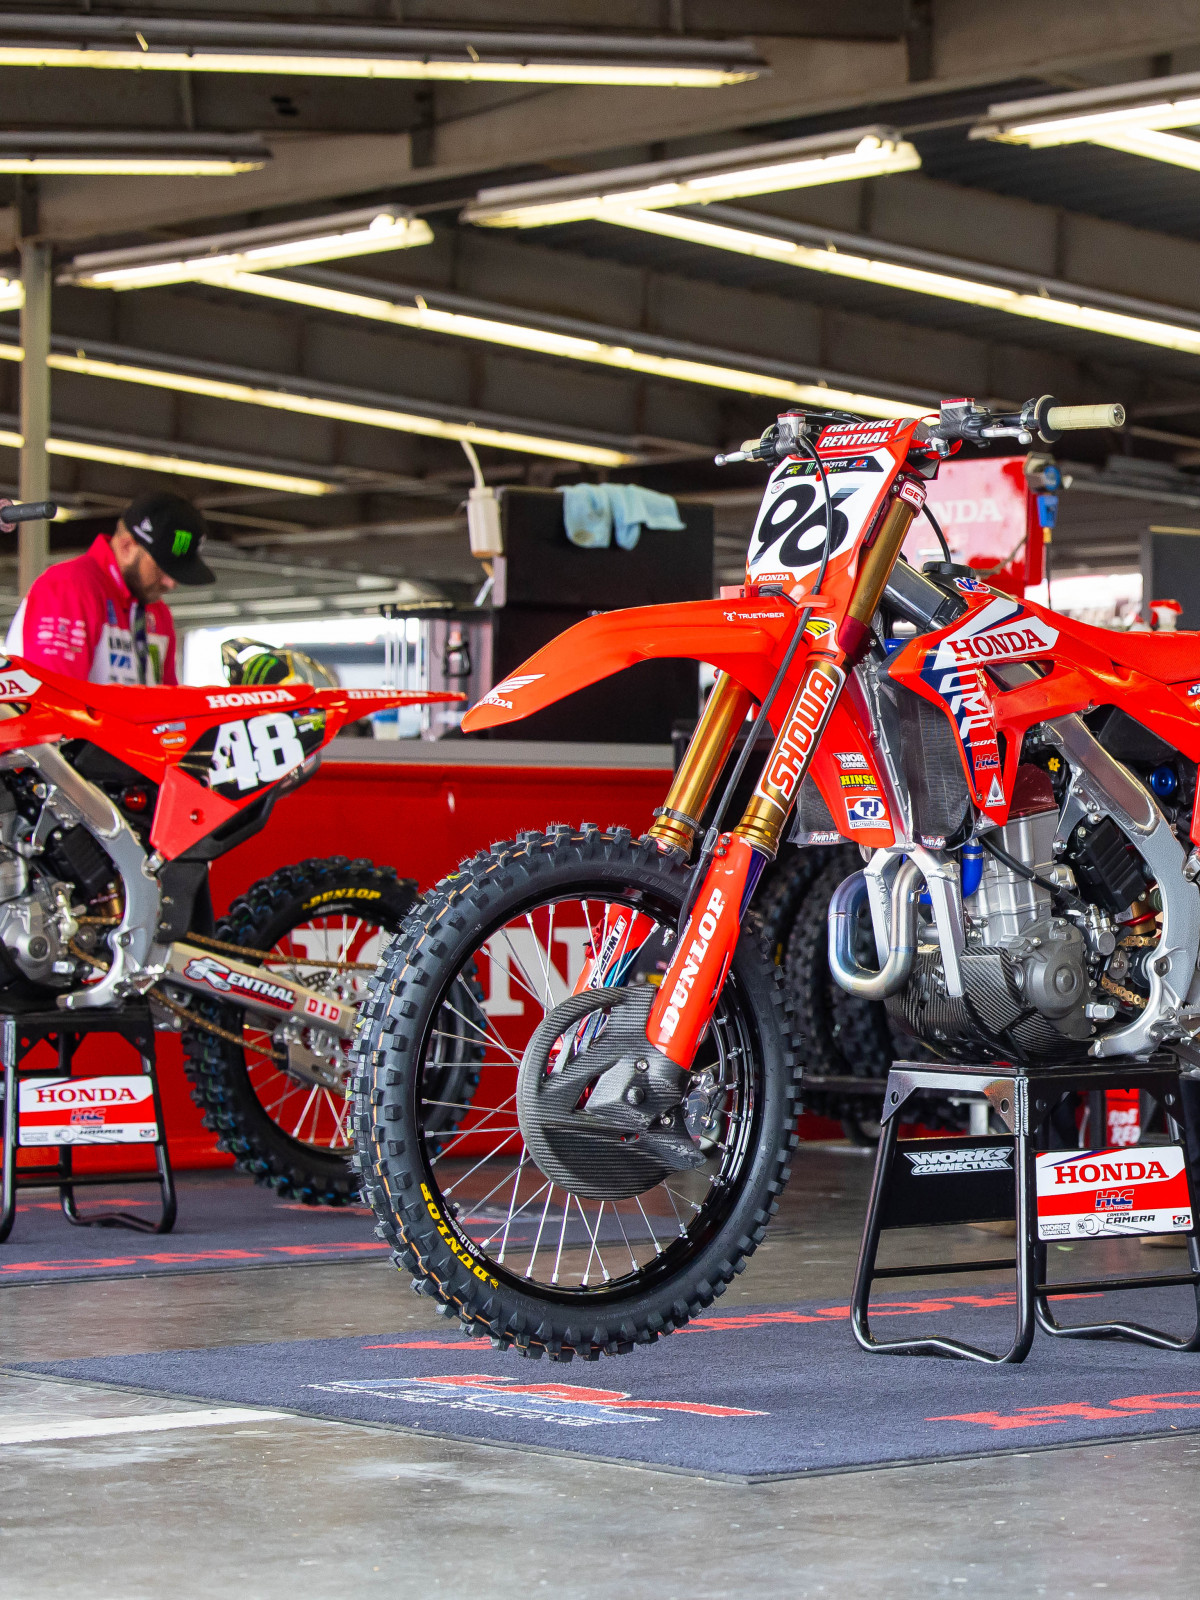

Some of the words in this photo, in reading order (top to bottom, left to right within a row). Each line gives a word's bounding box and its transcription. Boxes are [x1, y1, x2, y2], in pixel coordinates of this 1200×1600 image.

[819, 431, 889, 448] RENTHAL
[899, 487, 922, 507] GET
[751, 483, 861, 567] 96
[757, 574, 790, 582] HONDA
[738, 611, 785, 620] TRUETIMBER
[947, 627, 1048, 662] HONDA
[206, 690, 296, 709] HONDA
[939, 668, 994, 740] CRF
[768, 669, 838, 800] SHOWA
[208, 712, 304, 791] 48
[860, 801, 879, 817] TJ
[310, 888, 382, 908] DUNLOP
[658, 887, 724, 1038] DUNLOP
[36, 1088, 137, 1103] HONDA
[910, 1147, 1013, 1164] WORKS
[911, 1160, 1012, 1174] CONNECTION
[1054, 1161, 1169, 1184] HONDA
[1095, 1189, 1134, 1207] HRC
[1106, 1215, 1155, 1224] CAMERA
[420, 1183, 490, 1282] DUNLOP
